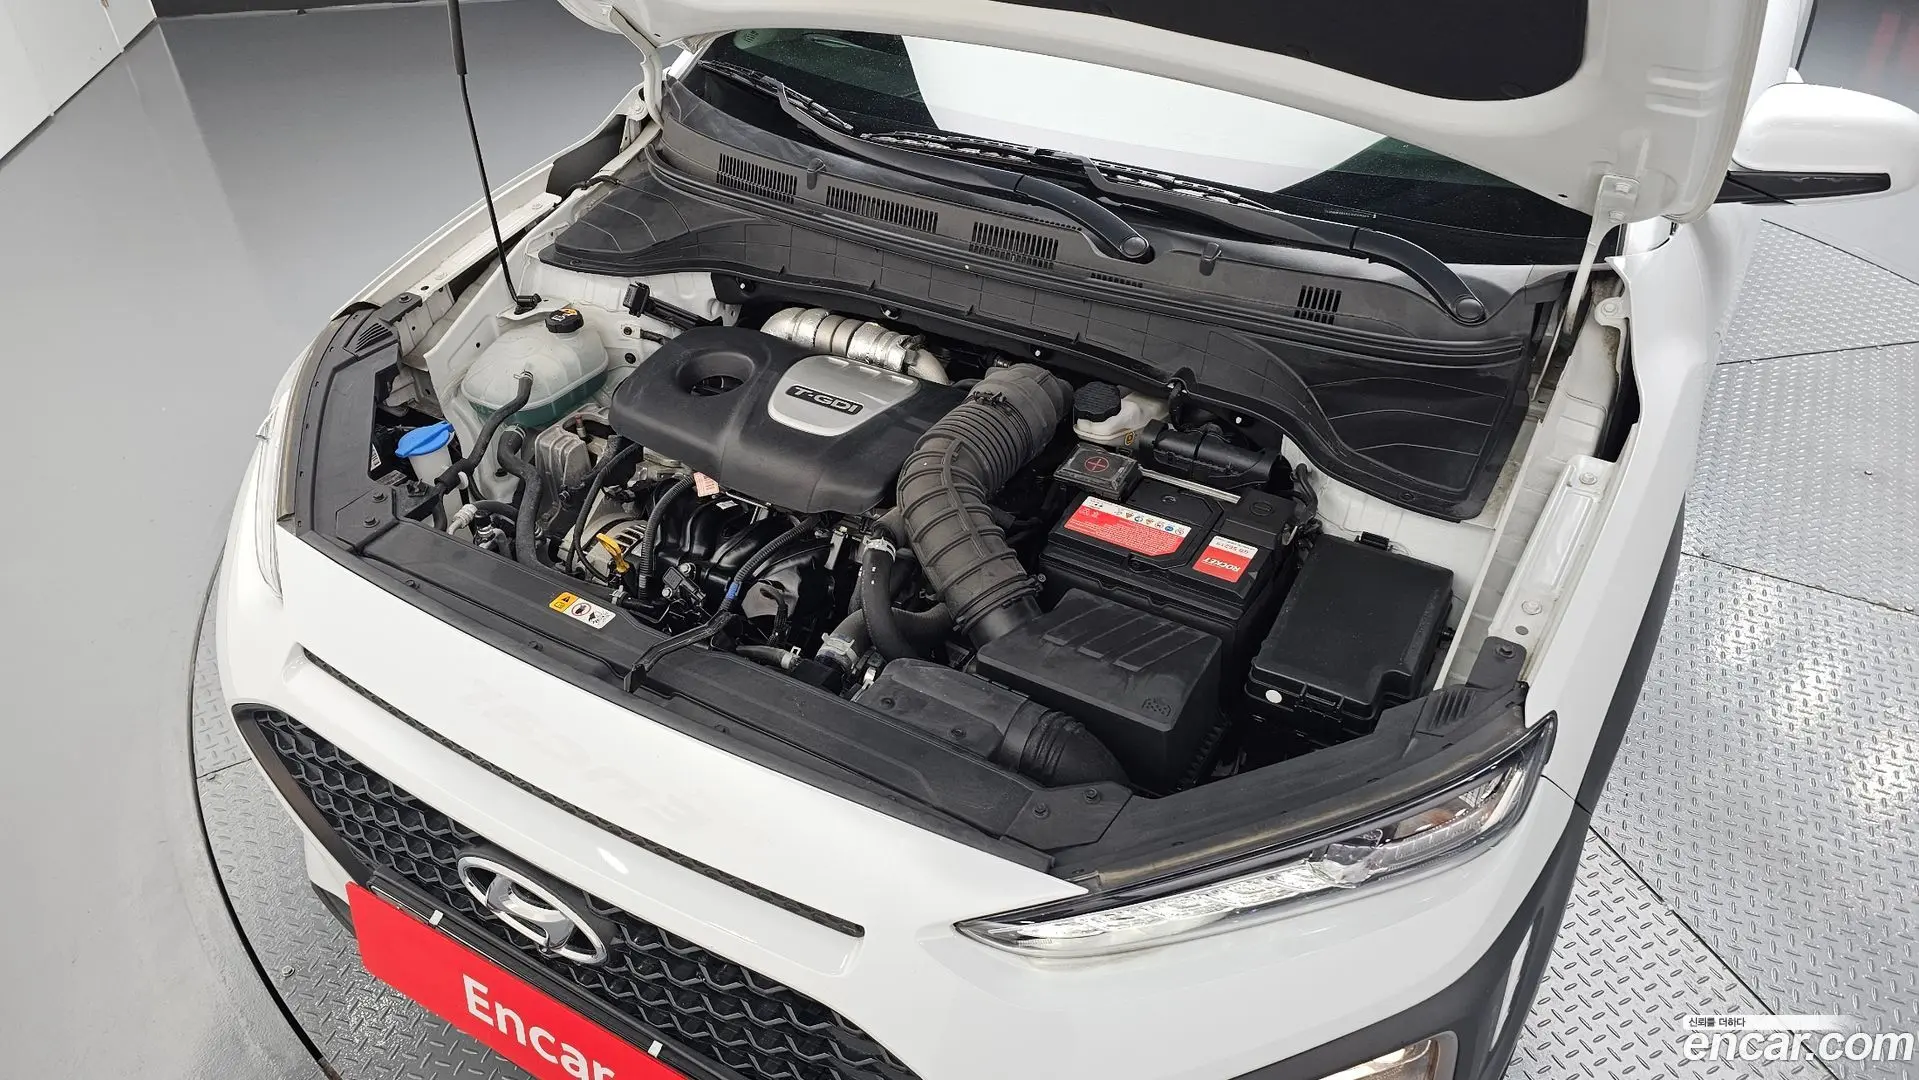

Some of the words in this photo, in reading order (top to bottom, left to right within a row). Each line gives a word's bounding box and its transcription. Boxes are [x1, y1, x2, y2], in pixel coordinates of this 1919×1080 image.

[795, 387, 858, 412] T-GDI
[1203, 558, 1241, 572] ROCKET
[463, 974, 614, 1080] Encar
